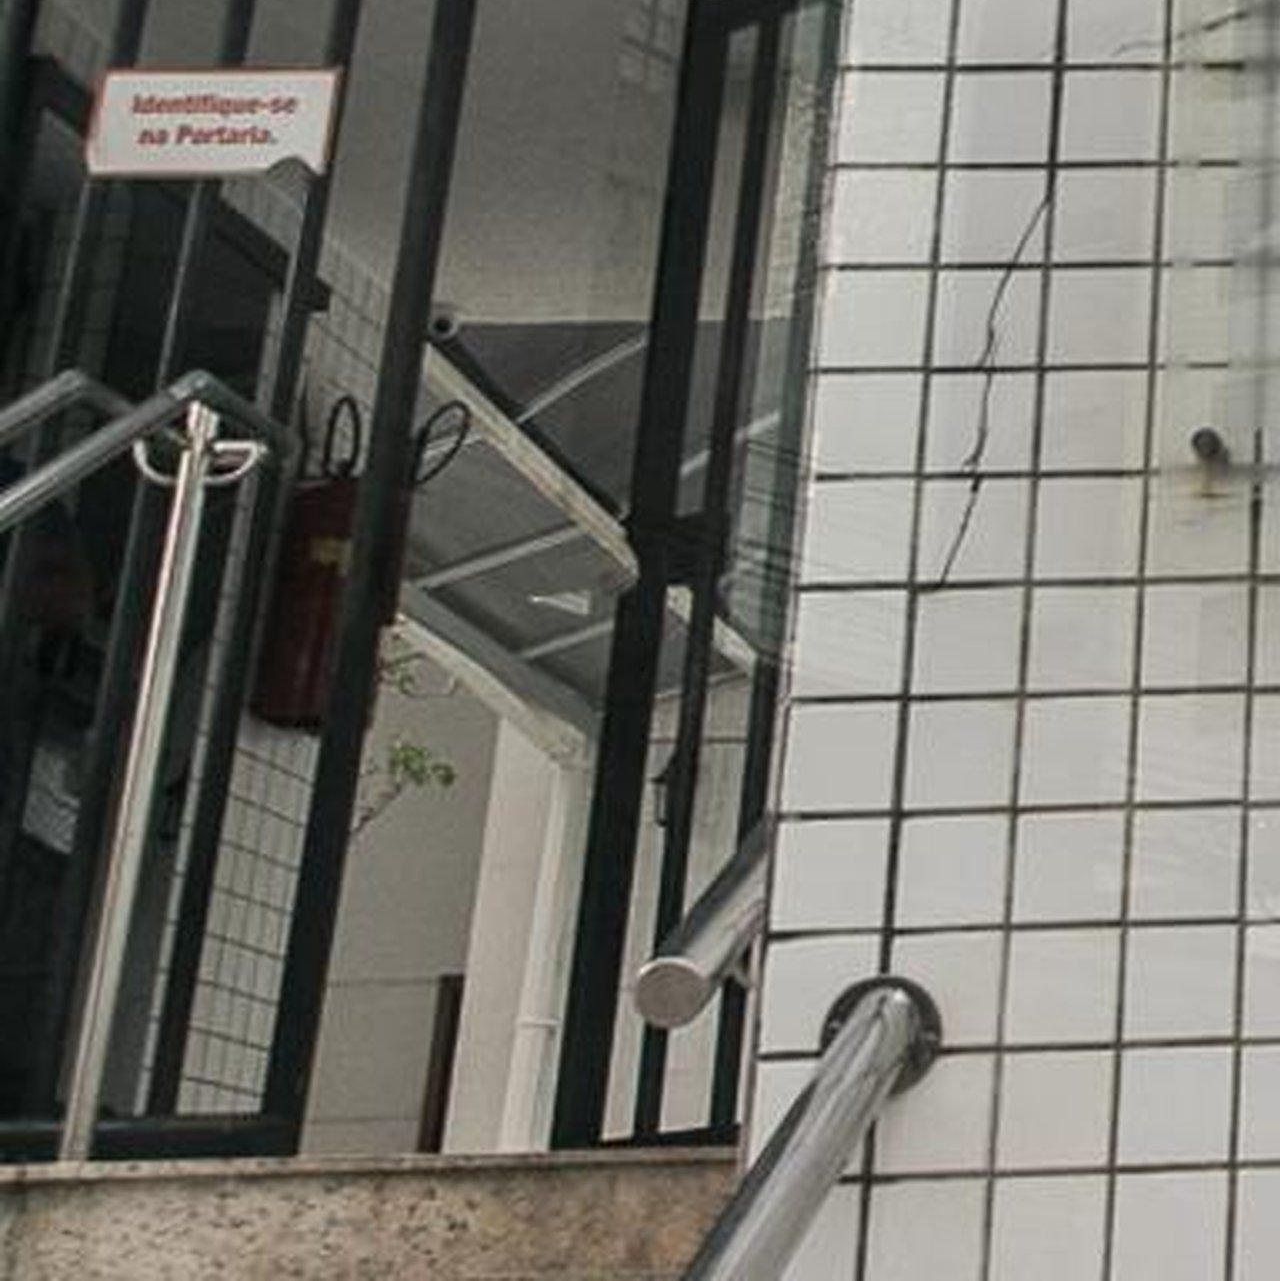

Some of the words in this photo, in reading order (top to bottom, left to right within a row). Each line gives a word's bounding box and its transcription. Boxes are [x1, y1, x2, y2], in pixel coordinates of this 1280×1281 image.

[131, 94, 297, 116] Identifique-se
[137, 128, 169, 145] na
[175, 124, 279, 145] Portaria.
